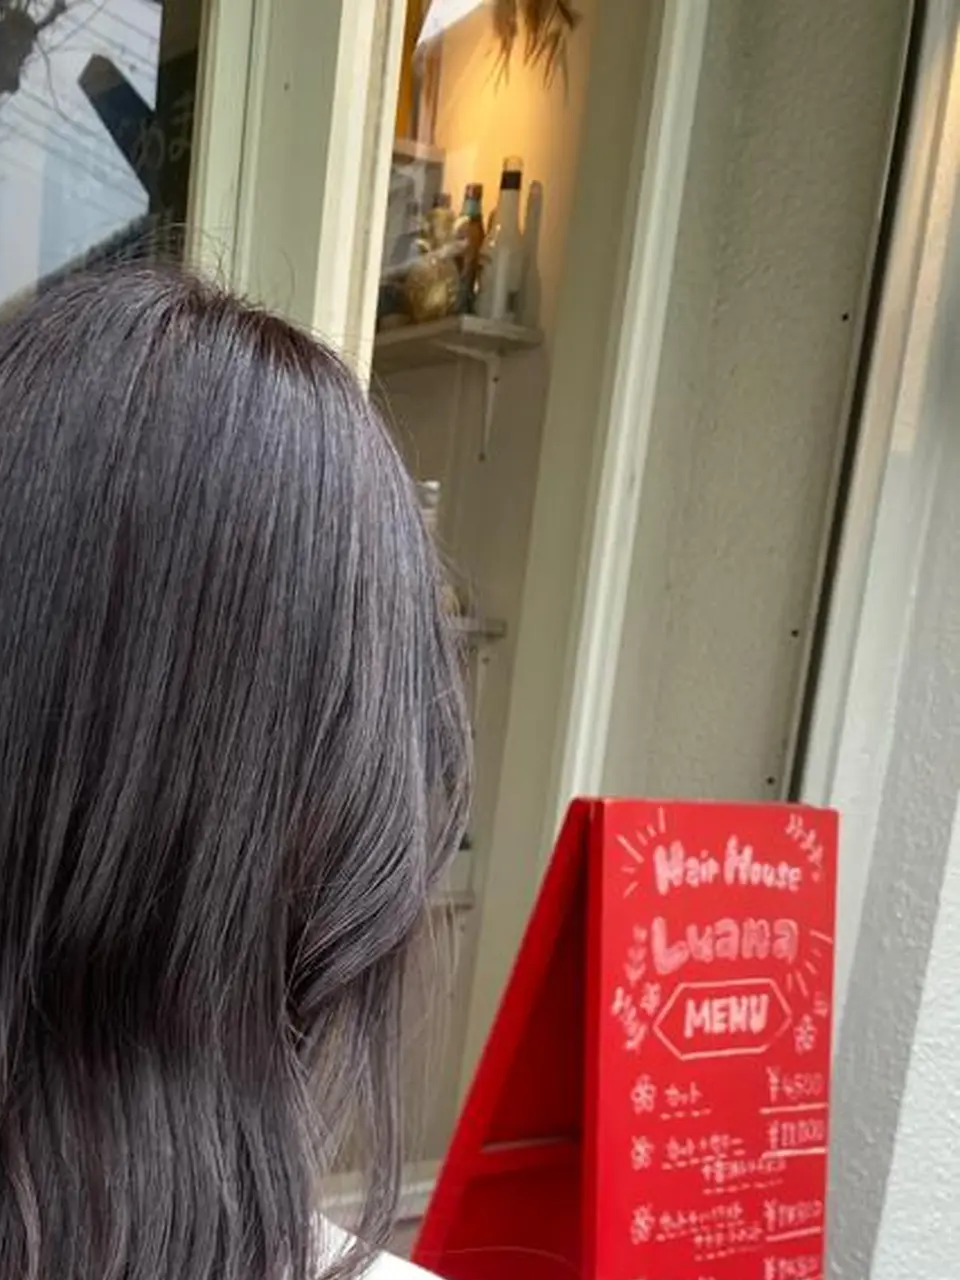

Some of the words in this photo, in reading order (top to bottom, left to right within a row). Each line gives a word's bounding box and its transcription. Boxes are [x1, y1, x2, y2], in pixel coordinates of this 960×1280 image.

[653, 840, 721, 895] Hair
[723, 834, 803, 892] House
[650, 916, 799, 975] Luana
[683, 994, 770, 1039] MENU
